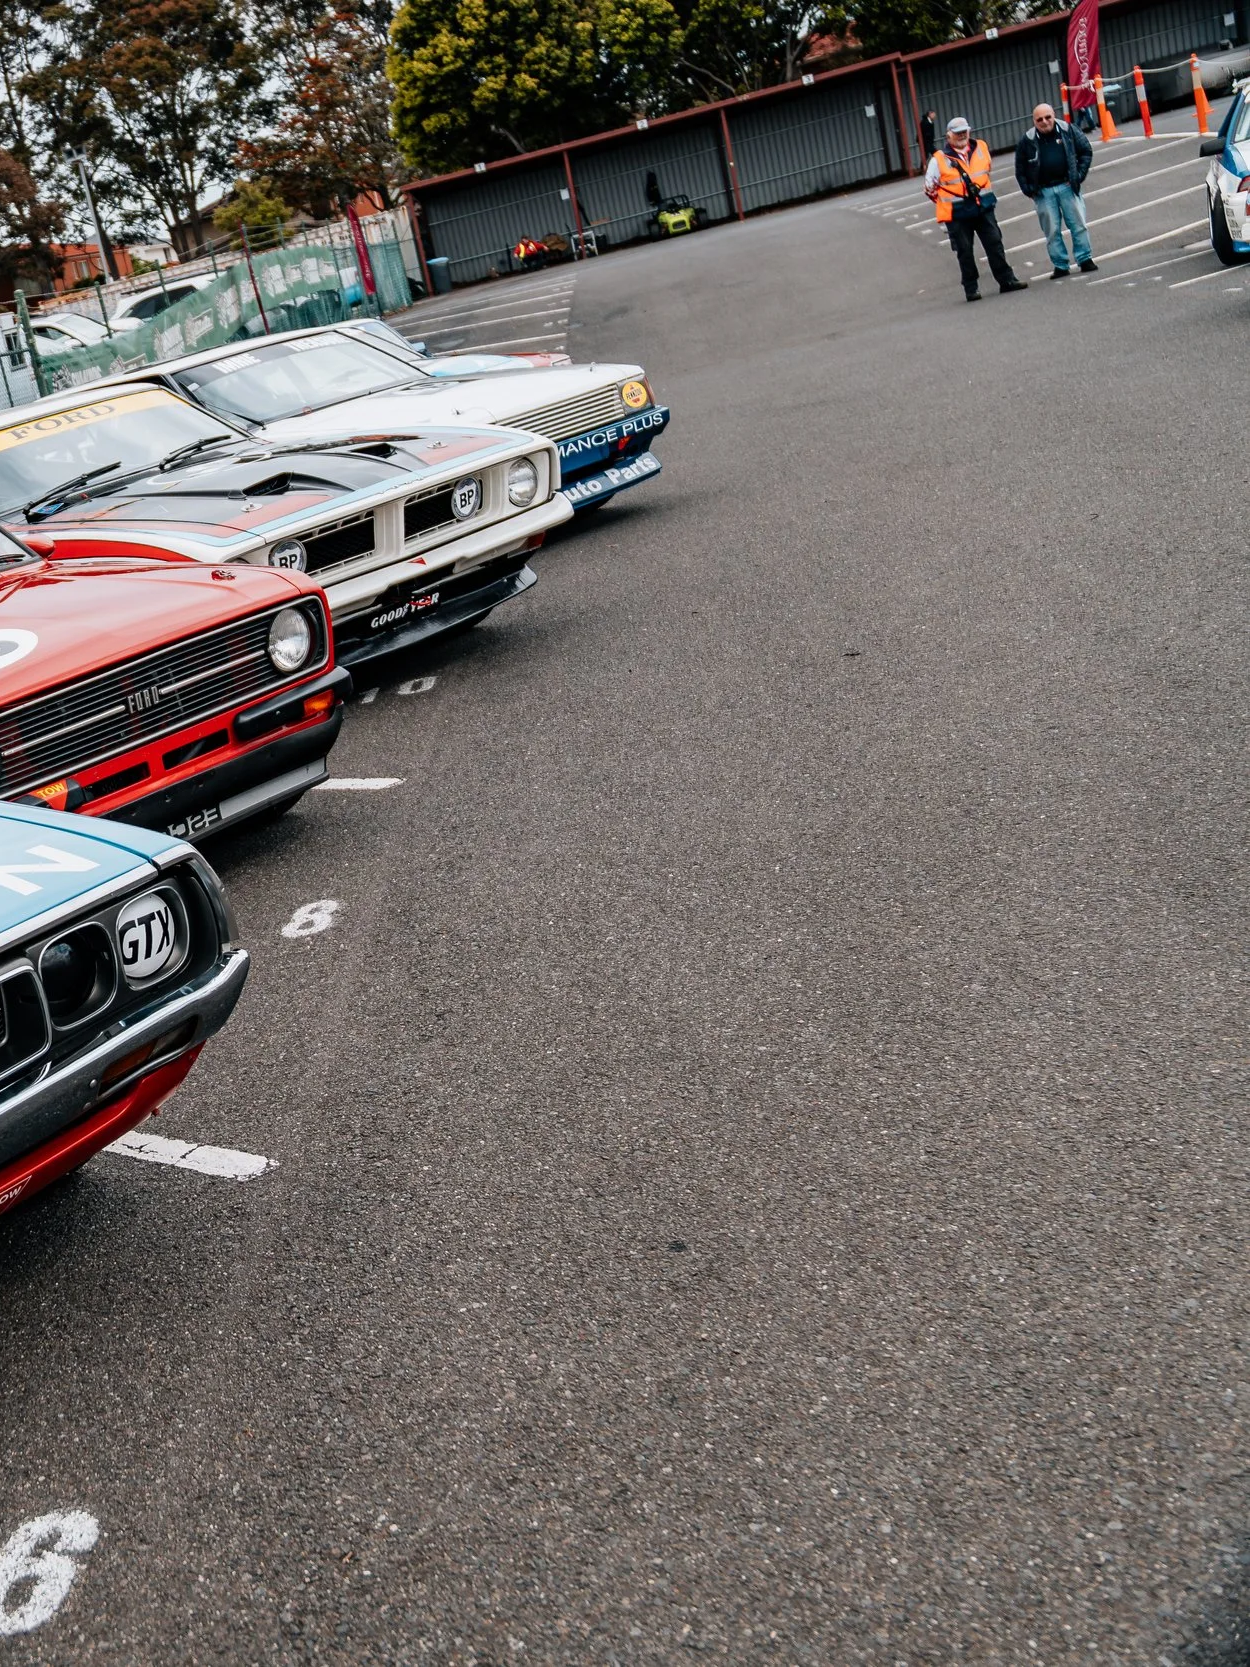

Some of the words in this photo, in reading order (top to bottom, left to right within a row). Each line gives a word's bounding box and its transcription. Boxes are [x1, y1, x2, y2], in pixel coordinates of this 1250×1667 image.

[6, 404, 117, 441] FORD
[622, 412, 664, 437] PLUS
[562, 480, 603, 500] uto
[604, 457, 658, 484] Parts
[459, 489, 475, 509] BP
[278, 553, 299, 569] BP
[127, 685, 161, 714] FORD
[36, 782, 66, 799] TOW
[121, 903, 171, 966] GTX
